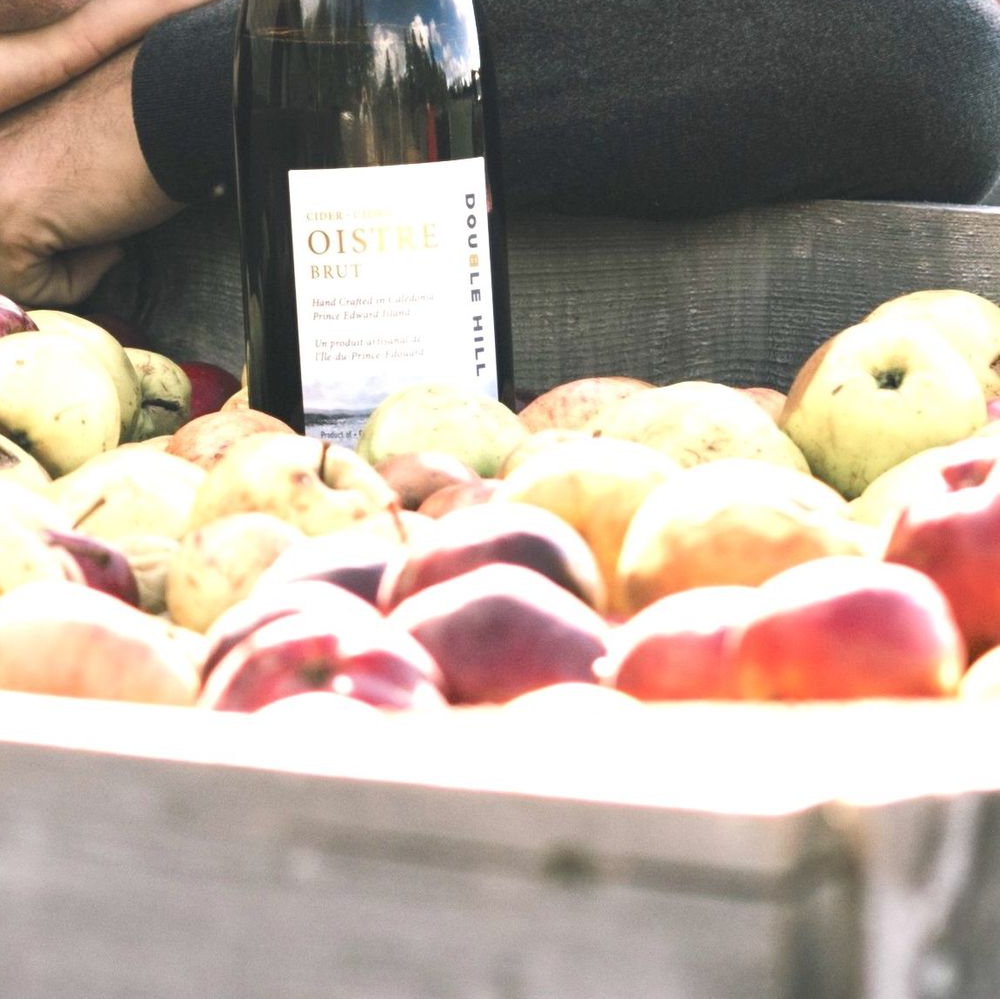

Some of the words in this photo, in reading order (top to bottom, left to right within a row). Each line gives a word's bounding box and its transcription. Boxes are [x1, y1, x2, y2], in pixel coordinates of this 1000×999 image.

[305, 211, 344, 221] CIDER
[307, 221, 440, 255] OISTRE
[310, 263, 362, 279] BRUT
[465, 193, 481, 302] DOUBLE
[473, 315, 486, 377] HILL
[312, 297, 336, 307] Hand
[339, 296, 373, 308] Crafted
[376, 296, 385, 305] in
[313, 311, 340, 321] Prince
[343, 310, 379, 320] Edward
[315, 339, 327, 348] Un
[329, 338, 364, 351] produit
[335, 351, 347, 361] du
[351, 350, 381, 361] Prince
[320, 431, 344, 439] Product
